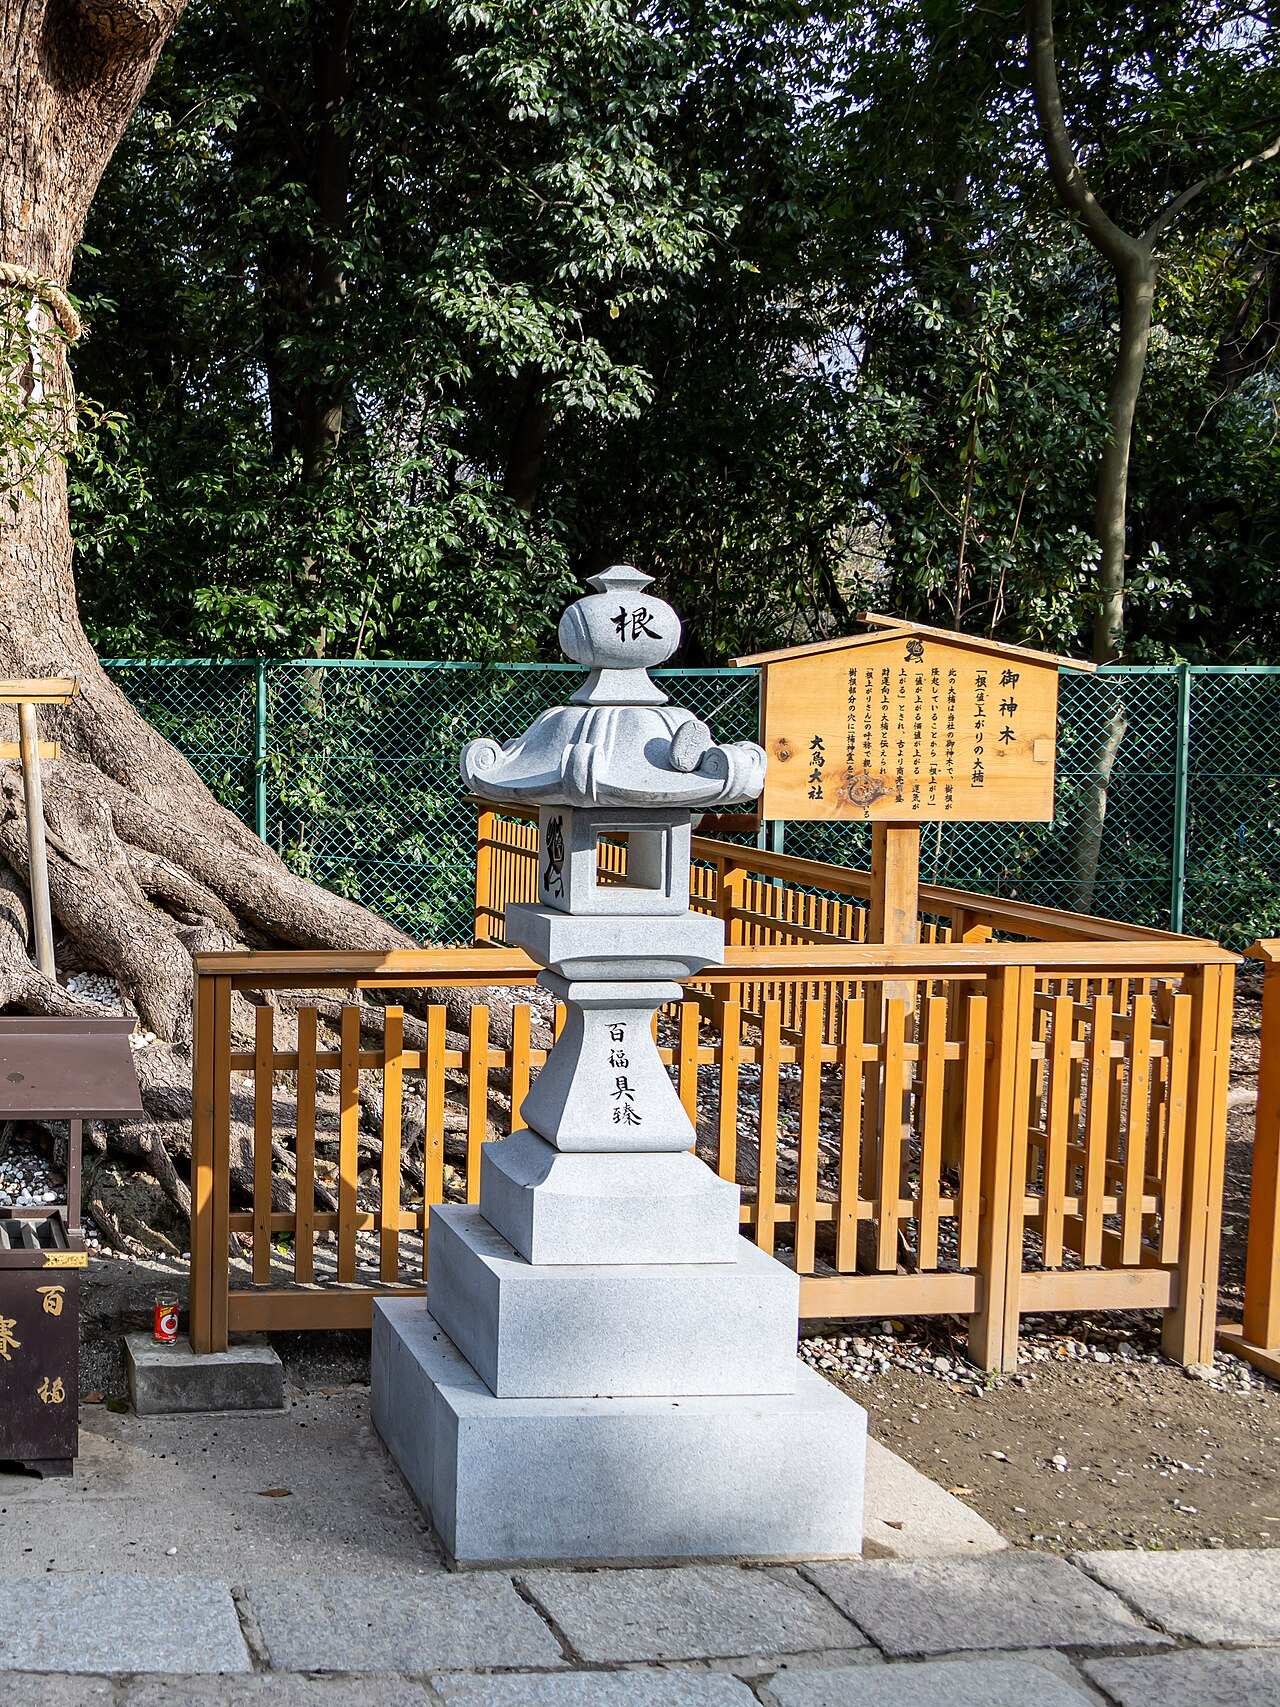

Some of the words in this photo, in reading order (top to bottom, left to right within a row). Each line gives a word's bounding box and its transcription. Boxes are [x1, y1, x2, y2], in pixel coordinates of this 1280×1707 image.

[610, 606, 663, 642] 根
[998, 669, 1020, 745] 御神木
[605, 1022, 642, 1126] 百福具臻
